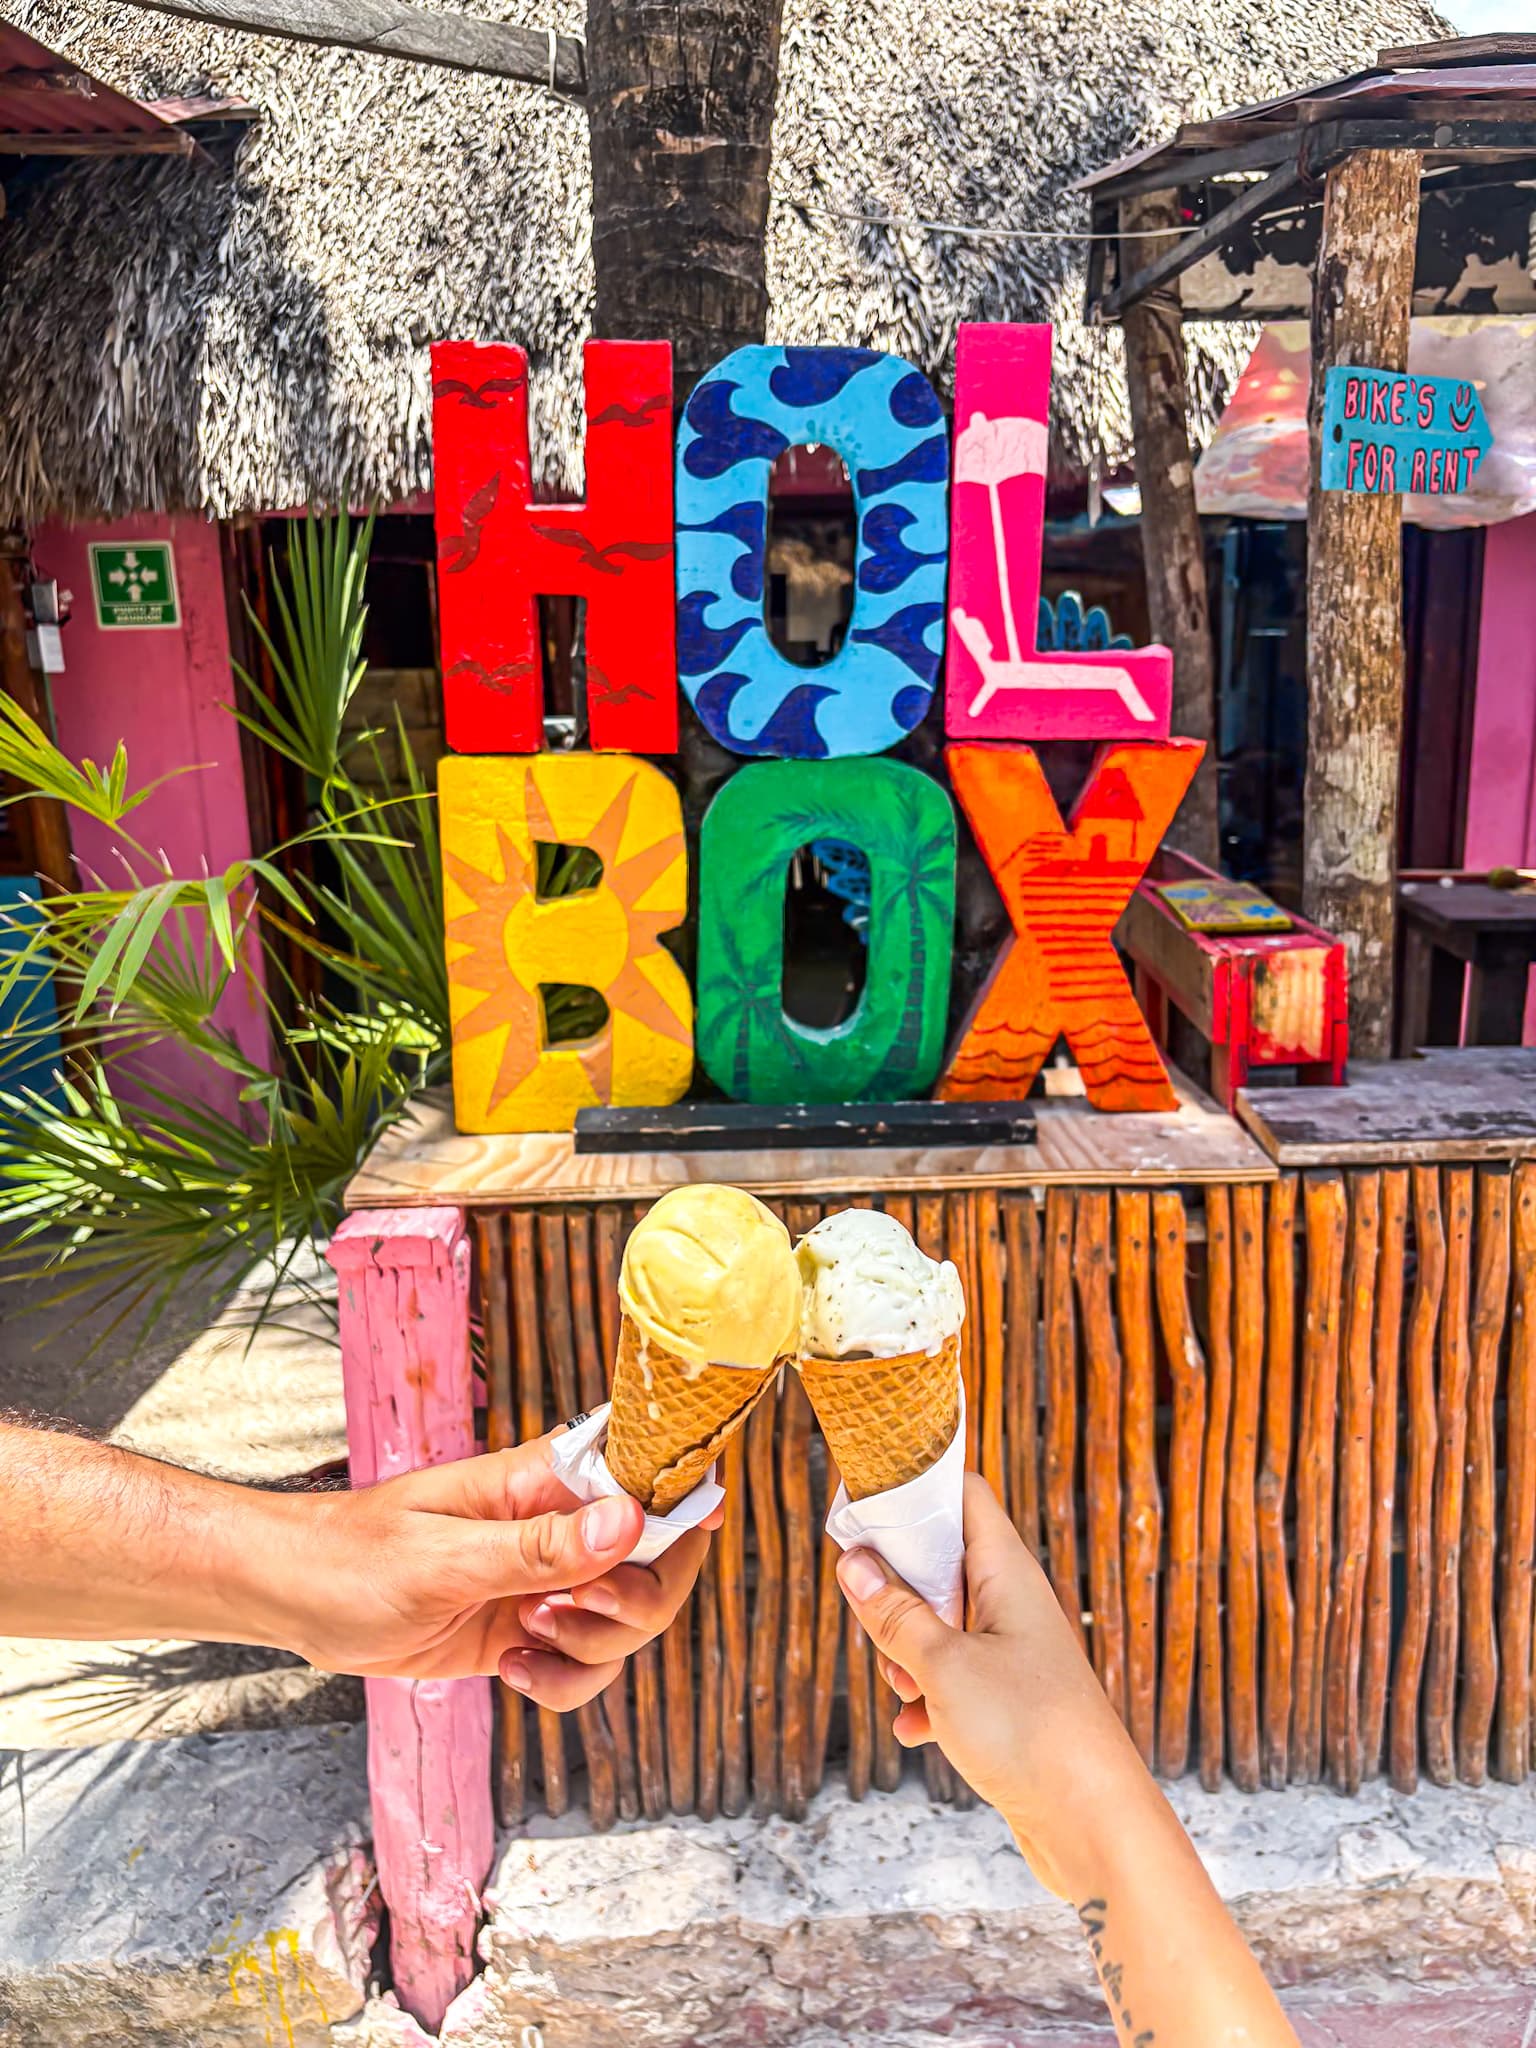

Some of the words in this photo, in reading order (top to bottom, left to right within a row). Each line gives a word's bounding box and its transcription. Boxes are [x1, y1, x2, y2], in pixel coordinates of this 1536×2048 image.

[1344, 378, 1436, 429] BIKE'S
[1346, 439, 1396, 492] FOR
[1411, 447, 1480, 494] RENT
[430, 322, 1173, 758] HOL
[436, 740, 1206, 1135] BOX
